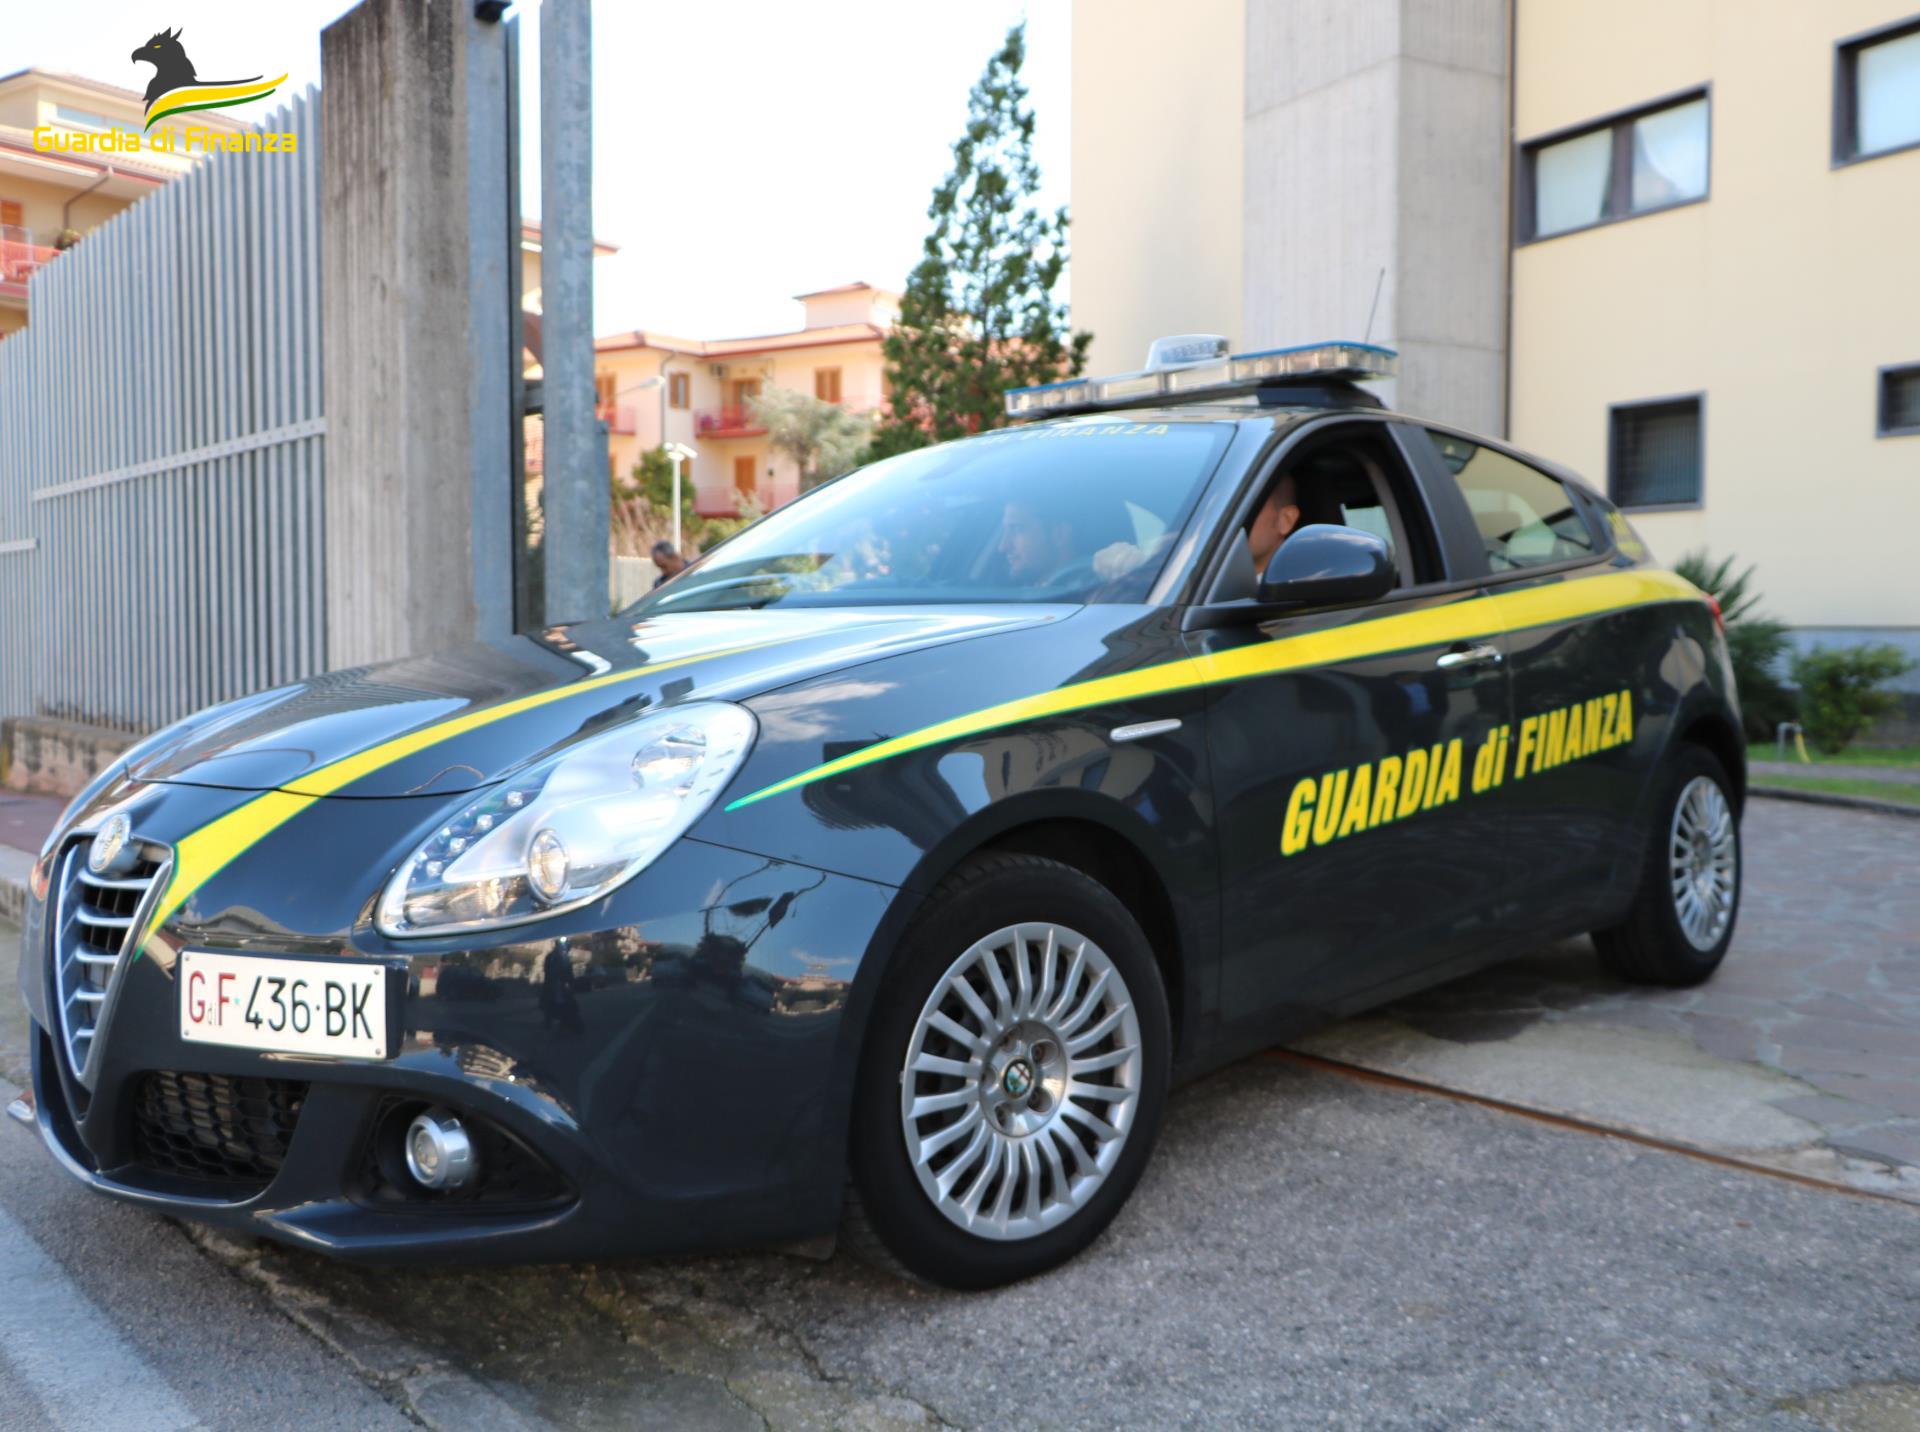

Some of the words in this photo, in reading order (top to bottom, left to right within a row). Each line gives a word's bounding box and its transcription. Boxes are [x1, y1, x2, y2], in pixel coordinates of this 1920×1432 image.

[1281, 738, 1463, 856] GUARDIA
[1472, 725, 1510, 793] di
[1514, 690, 1633, 779] FINANZA
